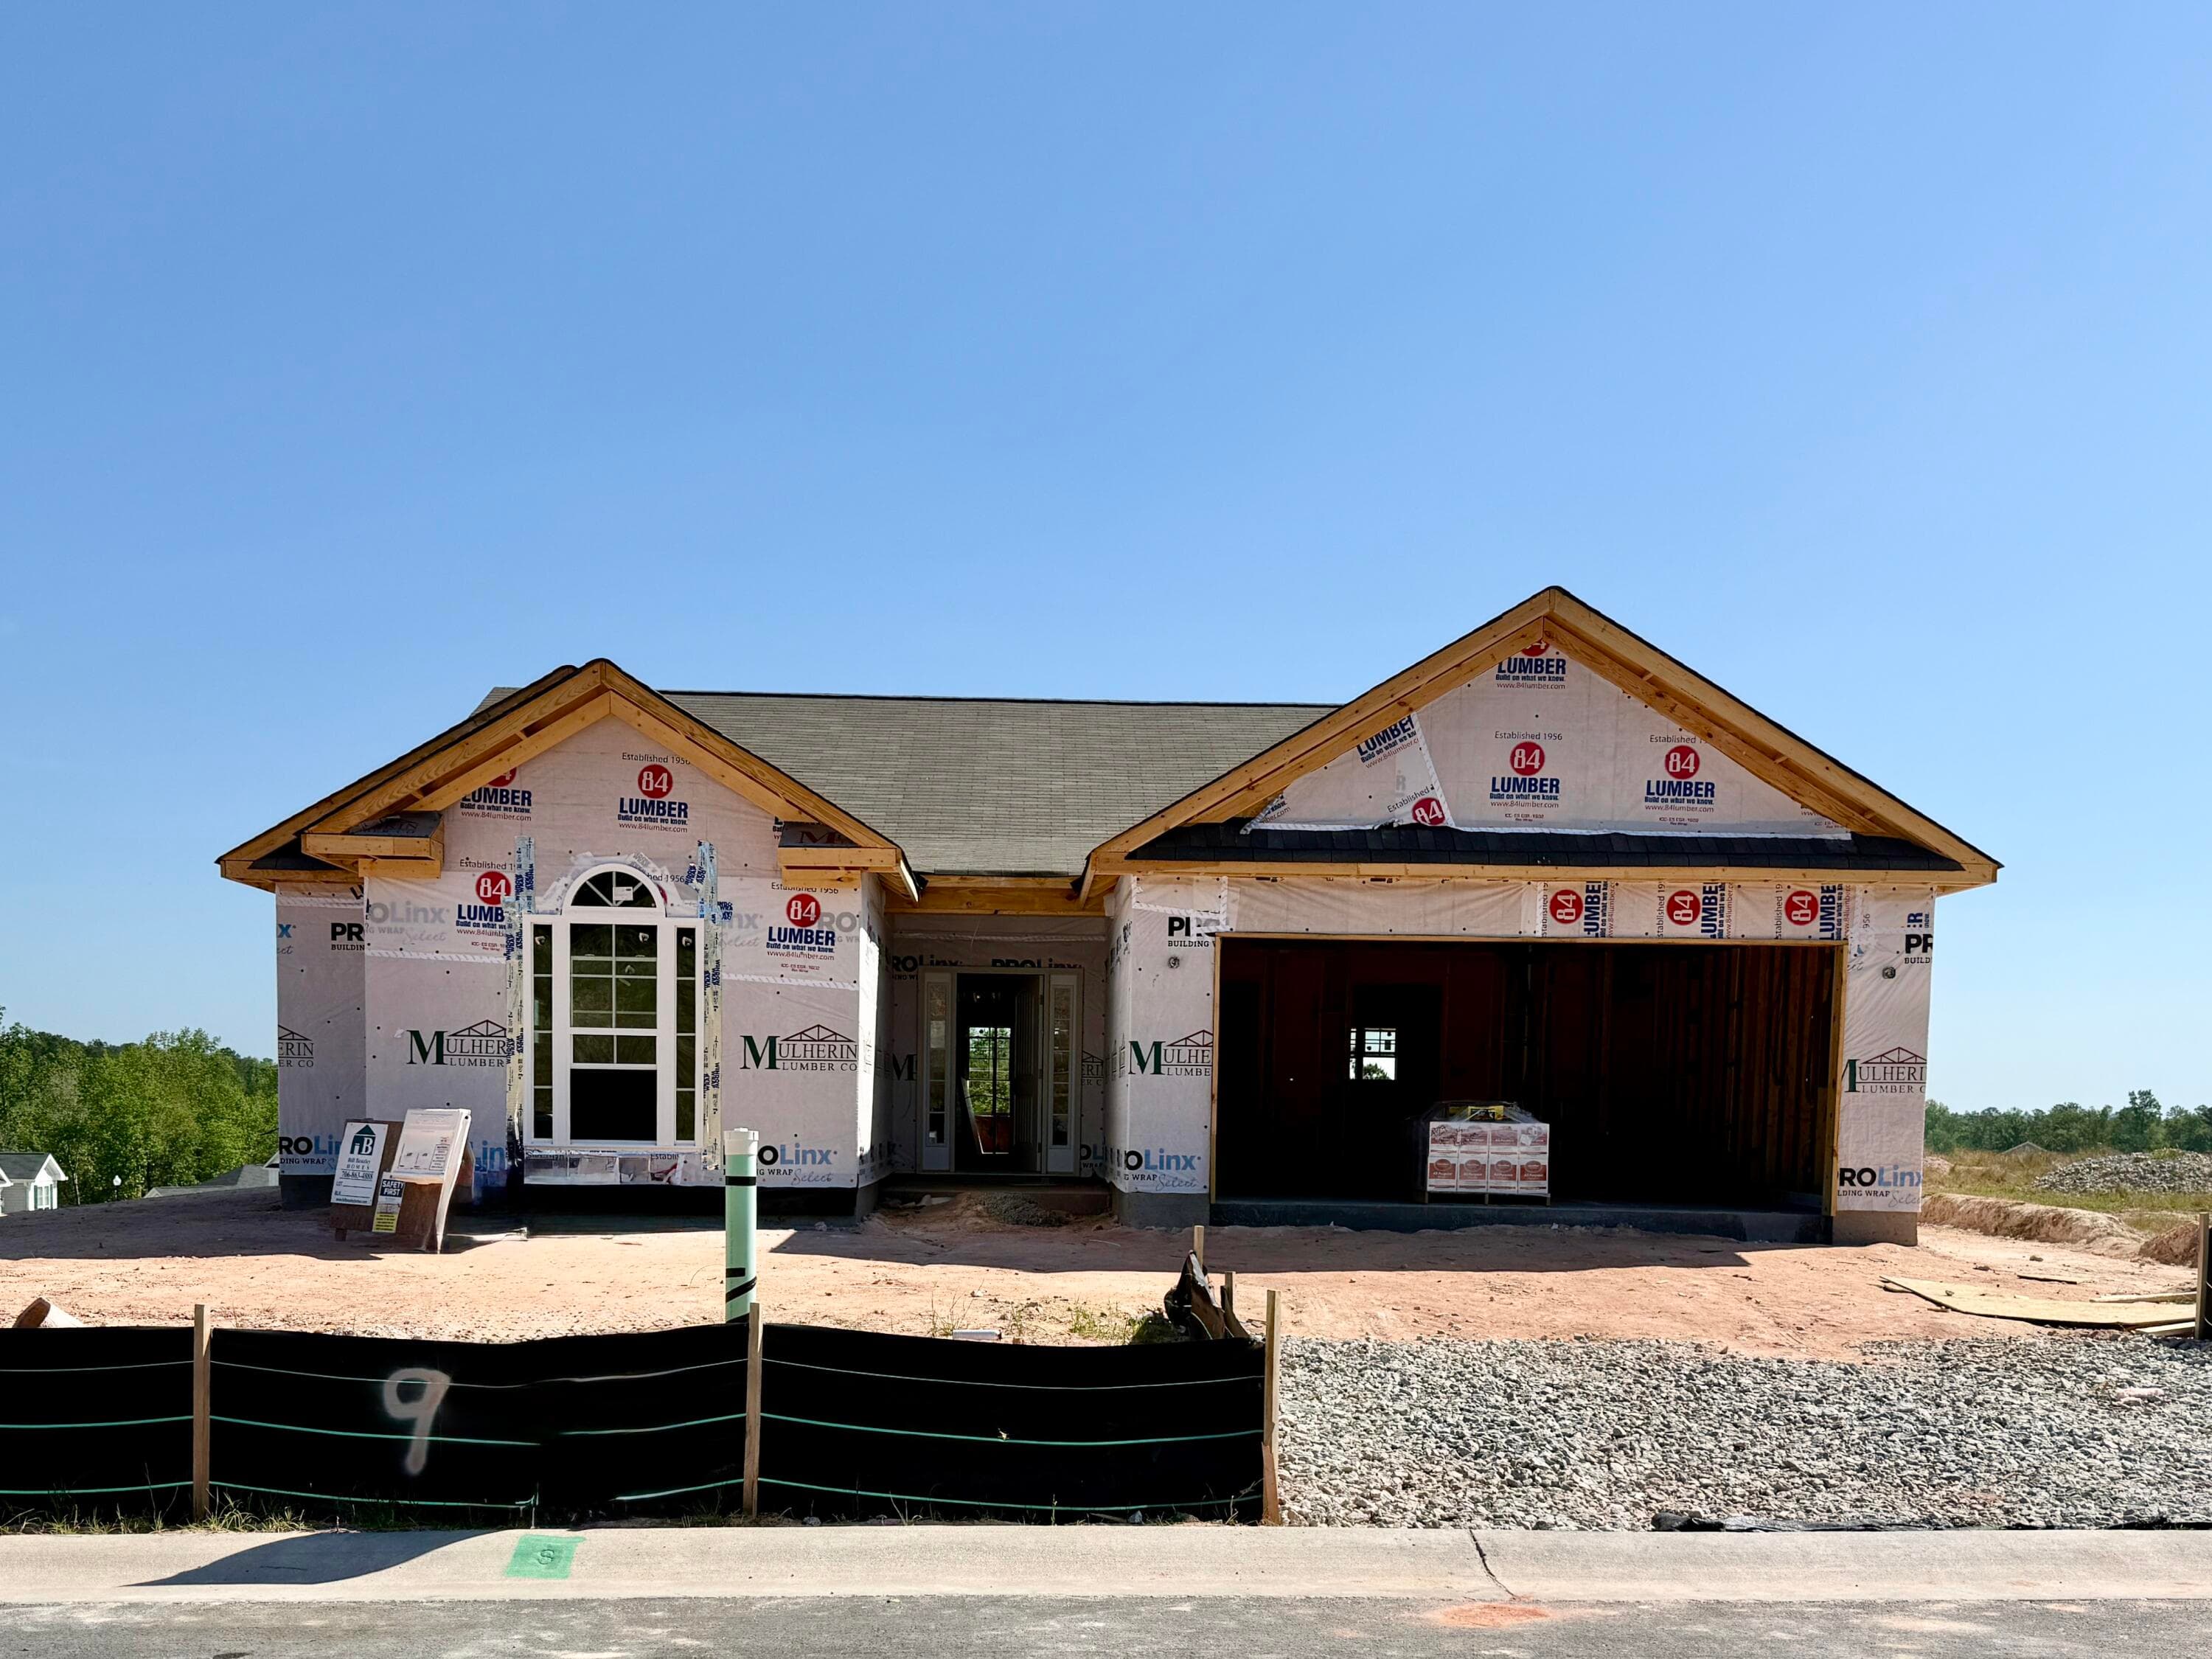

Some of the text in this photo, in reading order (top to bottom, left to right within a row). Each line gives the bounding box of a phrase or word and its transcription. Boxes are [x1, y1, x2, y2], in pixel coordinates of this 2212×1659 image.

[1498, 656, 1566, 674] LUMBER
[1357, 714, 1415, 756] LUMBE
[1495, 731, 1540, 740] Established
[1649, 734, 1696, 744] Established
[622, 752, 669, 763] Established
[1514, 748, 1540, 769] 84
[1669, 752, 1695, 773] 84
[641, 771, 669, 792] 84
[1491, 776, 1560, 794] LUMBER
[1646, 780, 1715, 798] LUMBER
[619, 797, 689, 818] LUMBER
[1387, 787, 1429, 813] Established
[1645, 804, 1714, 813] www.84lumber.com
[461, 811, 532, 821] www.84lumber.com
[1415, 801, 1443, 824] 84
[619, 823, 688, 833] www.84lumber.com
[460, 859, 507, 870] Established
[480, 877, 507, 898] 84
[666, 874, 685, 883] 1956
[458, 904, 505, 922] LUMB
[790, 900, 816, 922] 84
[1557, 894, 1576, 921] 84
[1584, 881, 1601, 938] UMBE
[1674, 894, 1694, 922] 84
[1701, 883, 1719, 939] UMBE
[1792, 894, 1812, 922] 84
[1819, 883, 1837, 940] LUMBE
[768, 926, 835, 947] LUMBER
[450, 1058, 505, 1068] LUMBER
[740, 1035, 858, 1070] MULHERIN
[298, 1060, 314, 1068] CO
[782, 1062, 858, 1071] LUMBER CO
[1841, 1059, 1927, 1093] MULHERI
[1862, 1085, 1914, 1093] LUMBER
[758, 1143, 832, 1165] OLinx
[383, 1181, 403, 1189] SAFETY
[383, 1368, 452, 1476] 9
[538, 1548, 554, 1565] S
